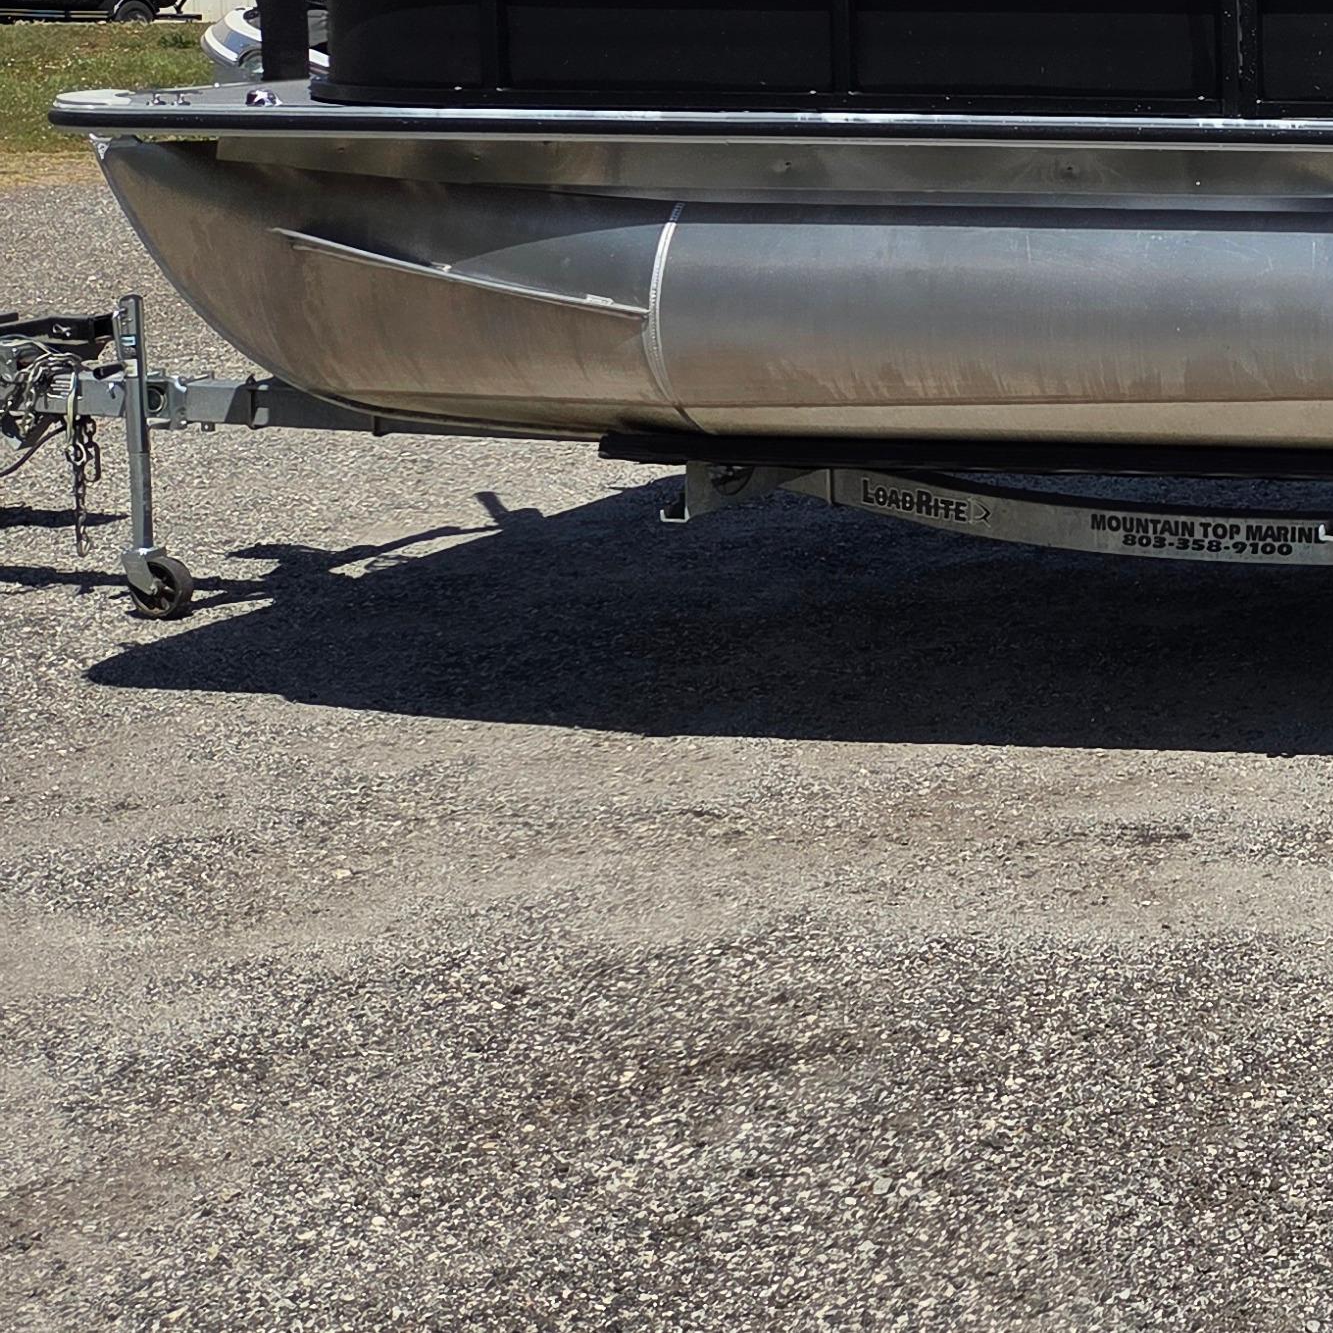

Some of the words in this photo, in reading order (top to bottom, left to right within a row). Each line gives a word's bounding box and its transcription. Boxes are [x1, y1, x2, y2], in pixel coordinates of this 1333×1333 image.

[1091, 514, 1195, 538] MOUNTAIN
[1199, 522, 1241, 541] TOP
[1122, 533, 1293, 556] 803-358-9100
